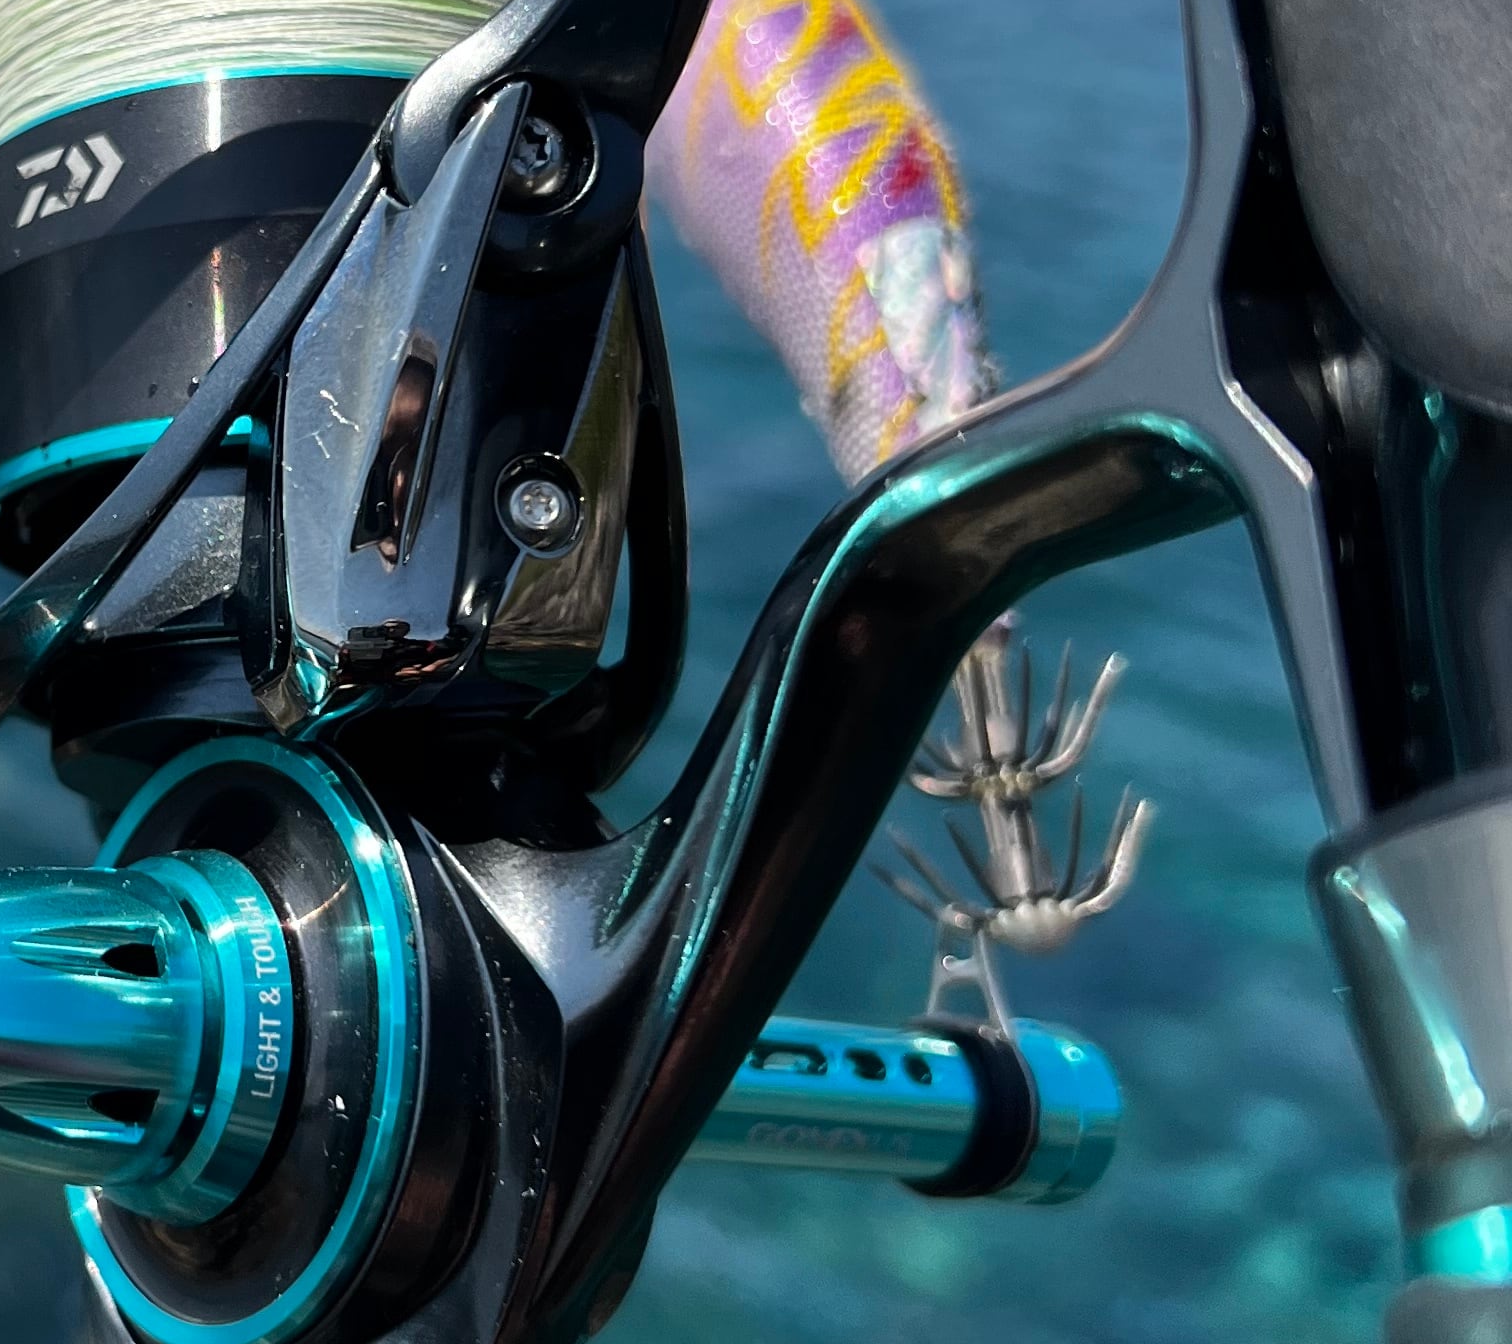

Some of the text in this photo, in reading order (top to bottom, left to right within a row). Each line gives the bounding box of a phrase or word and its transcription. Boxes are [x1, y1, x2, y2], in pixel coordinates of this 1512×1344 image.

[235, 895, 281, 1098] LIGHT & TOUGH
